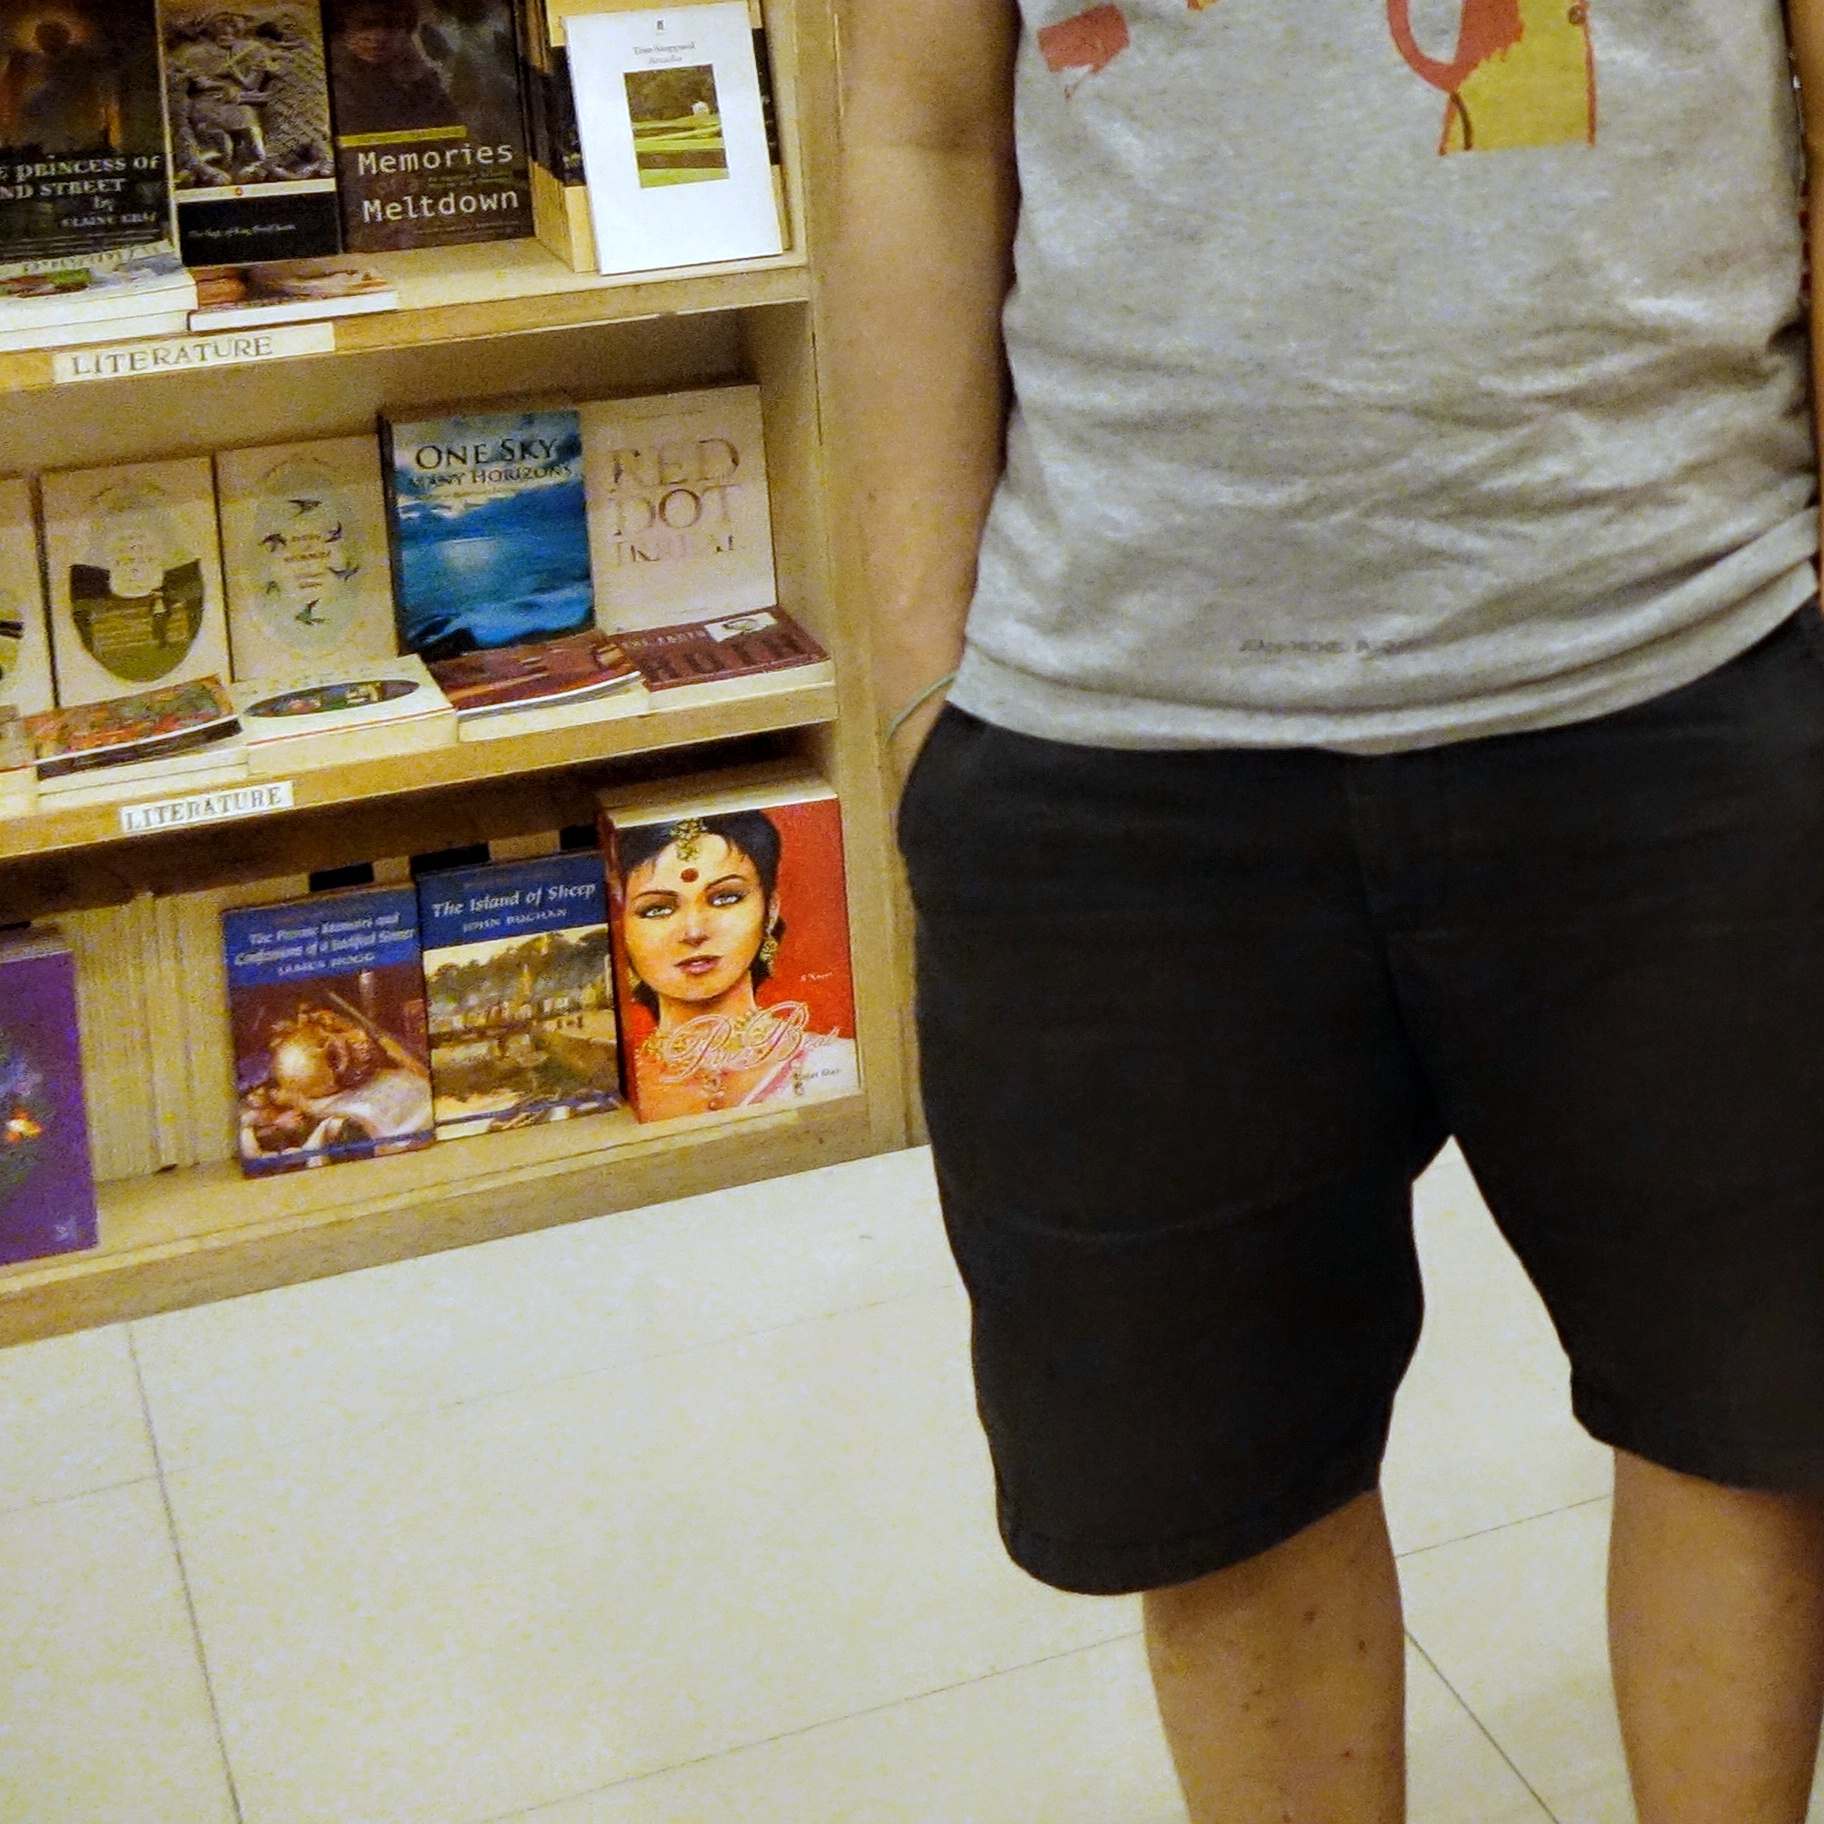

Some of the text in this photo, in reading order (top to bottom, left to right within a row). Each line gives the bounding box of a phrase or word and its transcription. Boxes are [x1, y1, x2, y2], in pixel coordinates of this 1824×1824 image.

[132, 152, 162, 172] OF
[356, 141, 516, 178] Memories
[50, 174, 126, 197] STREET
[362, 186, 520, 224] Meltdown
[71, 335, 273, 377] LITERATURE
[415, 436, 560, 471] ONE SKY
[613, 436, 741, 484] RED
[471, 464, 579, 486] HORIZONS
[616, 484, 741, 528] DOT
[124, 785, 284, 832] LITERATURE
[432, 882, 598, 920] The Island of Sheep
